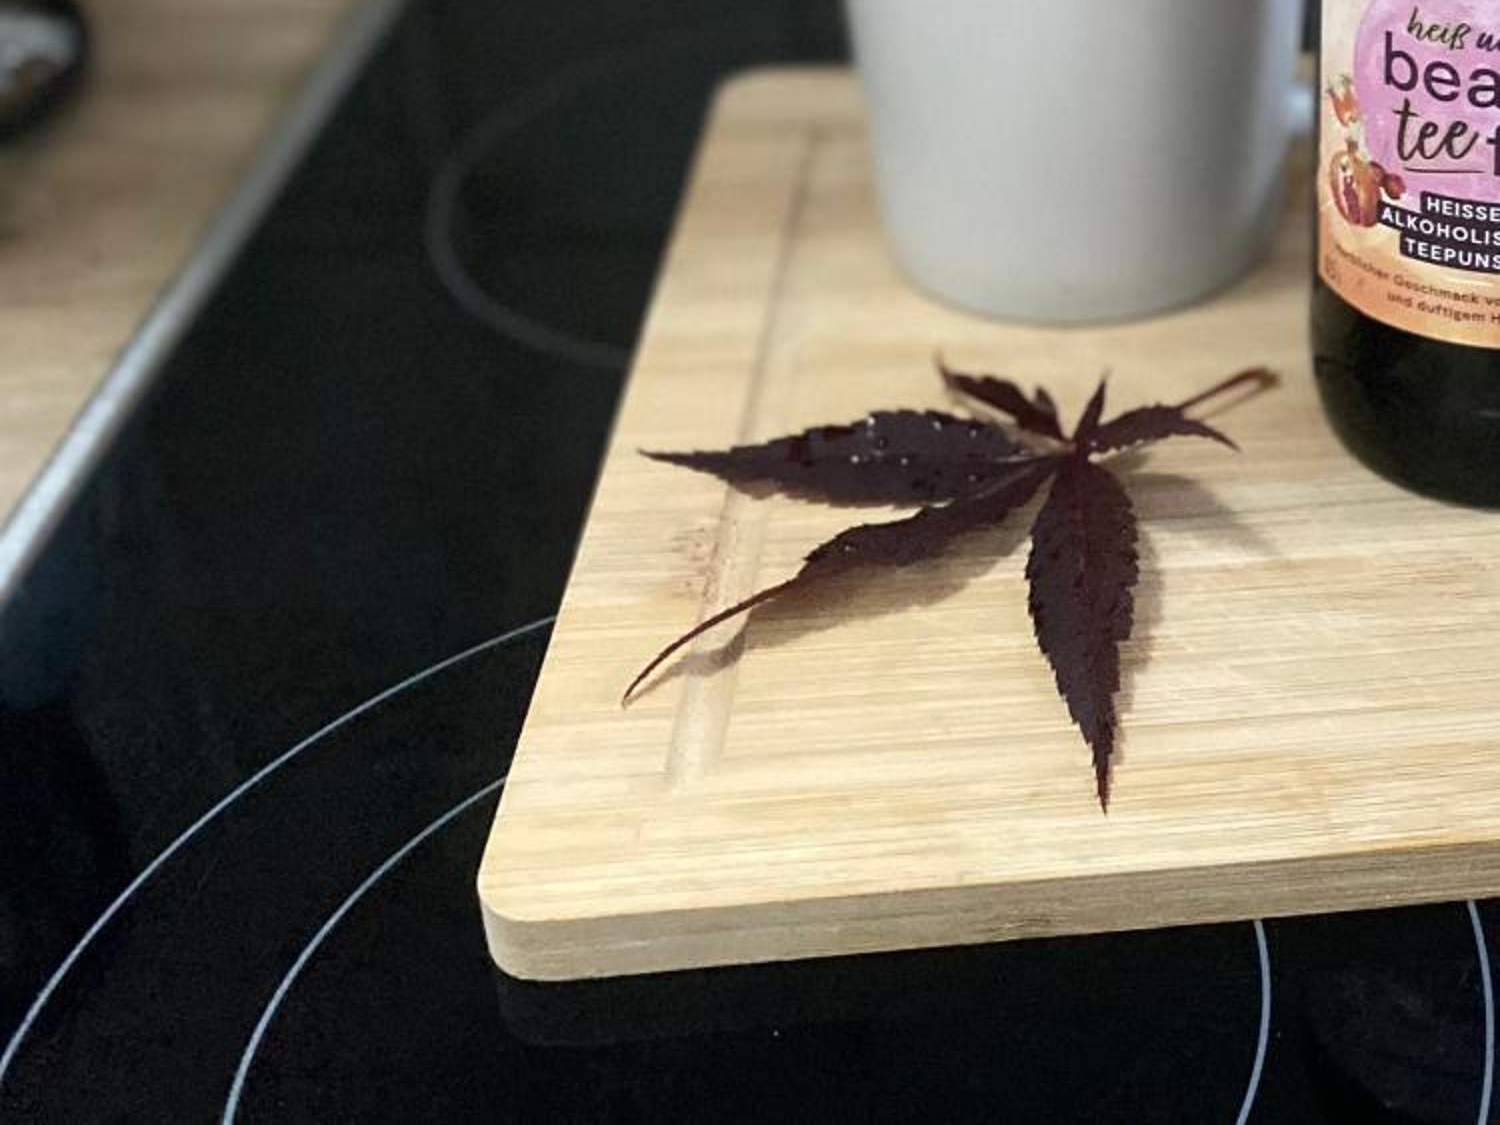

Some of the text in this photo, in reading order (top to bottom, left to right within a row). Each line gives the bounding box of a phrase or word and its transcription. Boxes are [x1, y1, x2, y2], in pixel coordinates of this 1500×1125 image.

[1407, 6, 1471, 50] heiß
[1392, 98, 1481, 162] tee
[1417, 300, 1486, 323] duftigem
